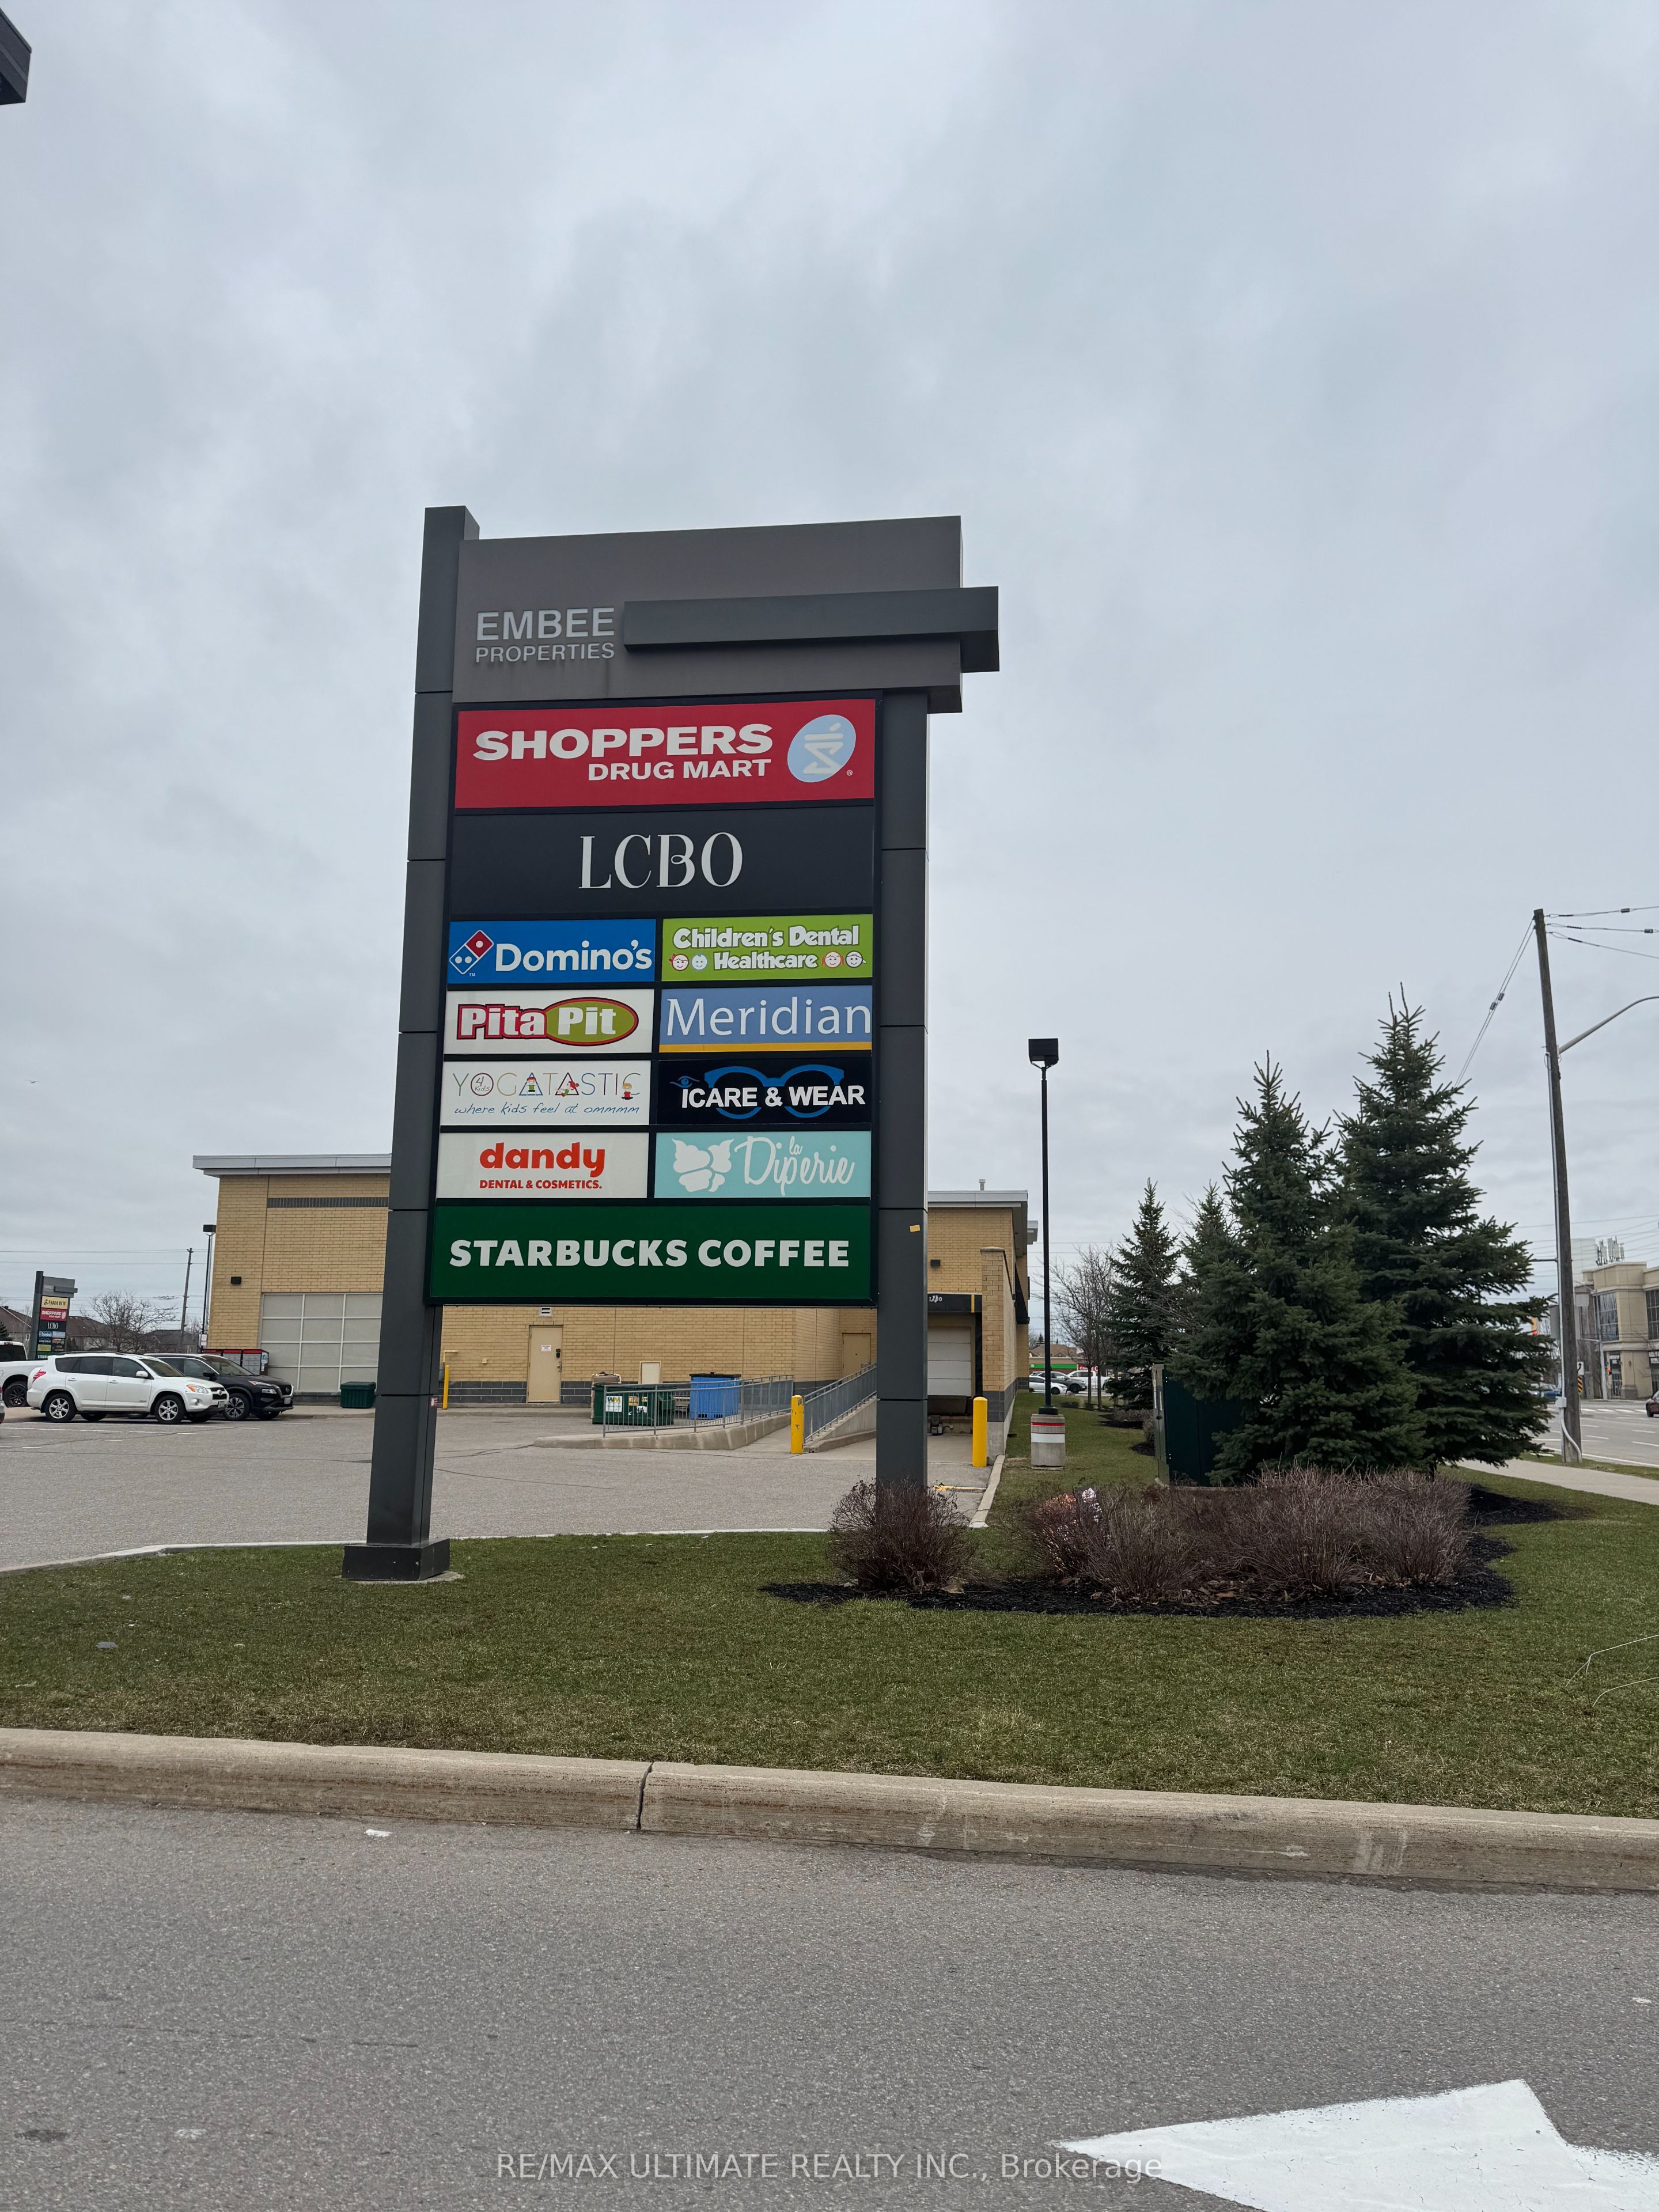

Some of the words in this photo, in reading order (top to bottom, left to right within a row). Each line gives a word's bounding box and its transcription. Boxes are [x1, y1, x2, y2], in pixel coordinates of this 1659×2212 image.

[476, 607, 615, 641] EMBEE
[476, 642, 615, 662] PROPERTIES
[472, 724, 773, 761] SHOPPERS
[588, 762, 674, 781] DRUG
[683, 759, 771, 779] MART
[578, 832, 743, 889] LCBO
[672, 926, 784, 949] Children's
[788, 924, 860, 947] Dental
[495, 940, 652, 972] Domino's
[713, 950, 819, 971] Healthcare
[459, 1006, 547, 1037] Pita
[558, 1006, 616, 1035] Pit
[666, 996, 871, 1036] Meridian
[452, 1072, 641, 1097] YOGATASTIC
[681, 1087, 758, 1108] ICARE
[764, 1086, 783, 1107] &
[788, 1085, 866, 1107] WEAR
[454, 1103, 495, 1114] where
[501, 1101, 528, 1116] kids
[533, 1103, 560, 1114] feel
[565, 1103, 578, 1113] at
[584, 1105, 639, 1114] ommmm
[789, 1135, 803, 1156] la
[479, 1142, 605, 1178] dandy
[734, 1135, 855, 1196] Diperie
[479, 1180, 524, 1190] DENTAL
[525, 1180, 533, 1190] &
[535, 1179, 603, 1190] COSMETICS.
[449, 1239, 688, 1267] STARBUCKS
[698, 1239, 849, 1267] COFFEE
